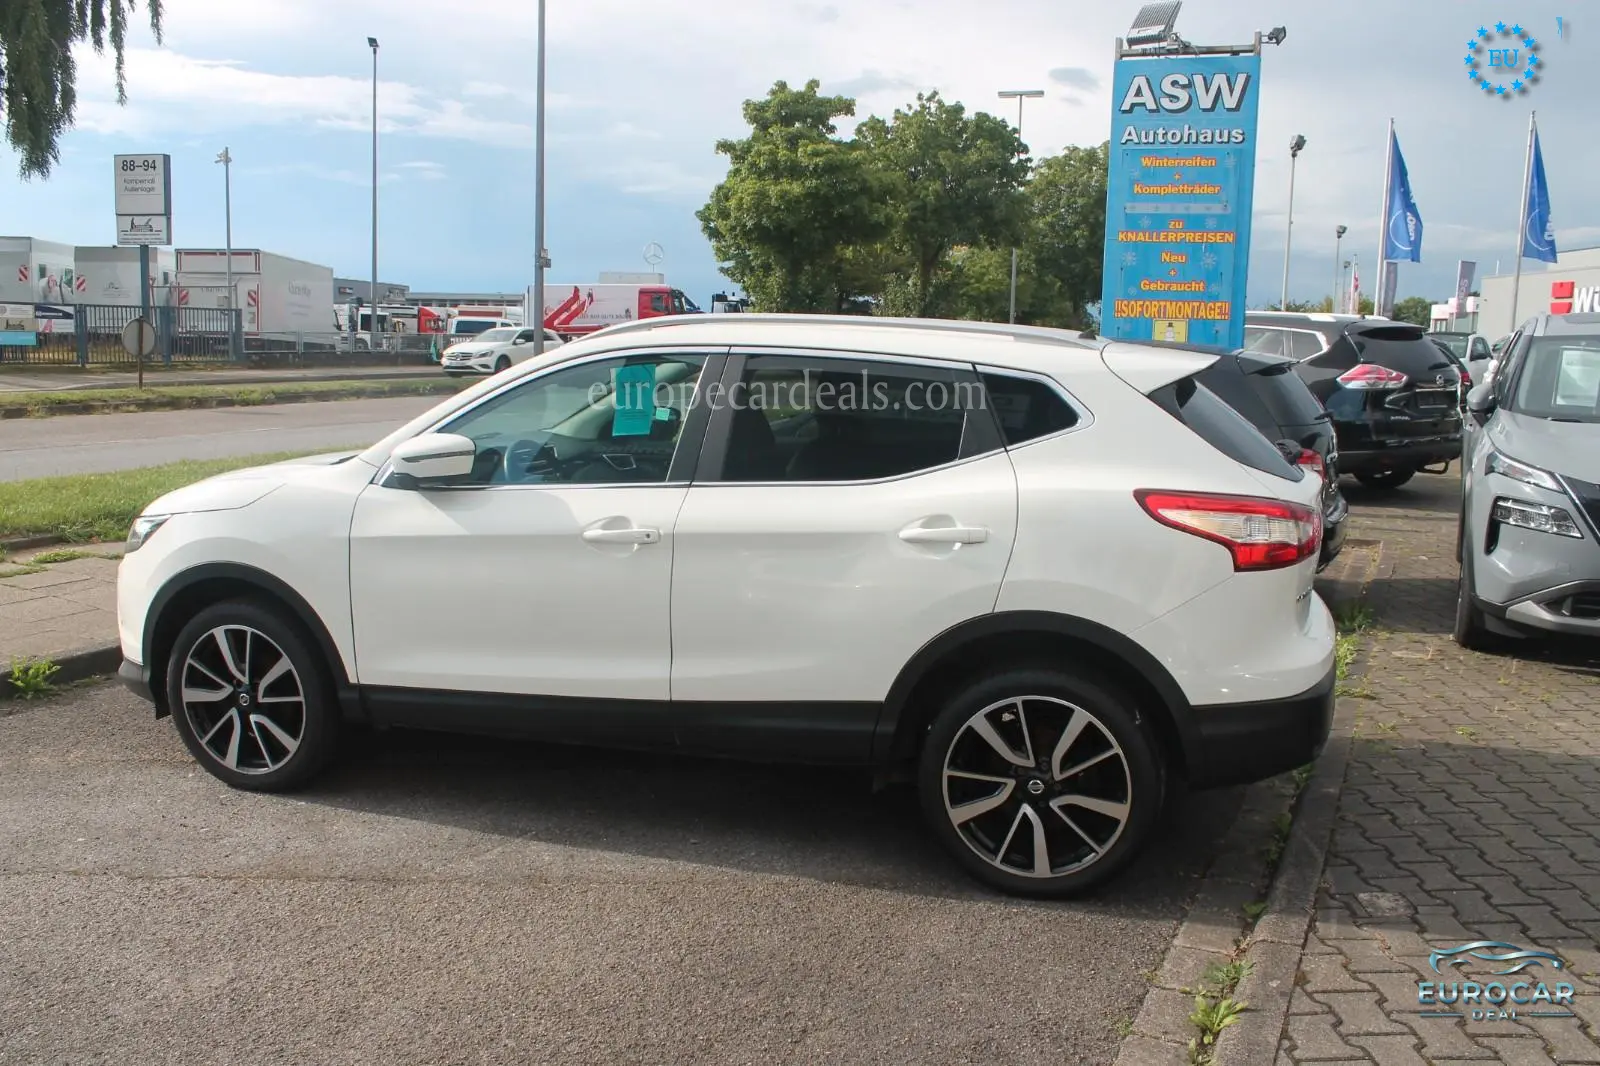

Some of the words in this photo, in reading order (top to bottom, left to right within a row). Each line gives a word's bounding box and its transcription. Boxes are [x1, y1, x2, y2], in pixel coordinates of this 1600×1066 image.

[1120, 73, 1251, 114] ASW
[1121, 125, 1245, 145] Autohaus
[1141, 156, 1216, 168] Winterreifen
[1133, 183, 1220, 196] Kompletträder
[1168, 220, 1183, 229] zu
[1118, 231, 1234, 244] KNALLERPREISEN
[1161, 252, 1186, 264] Neu
[1140, 280, 1205, 292] Gebraucht
